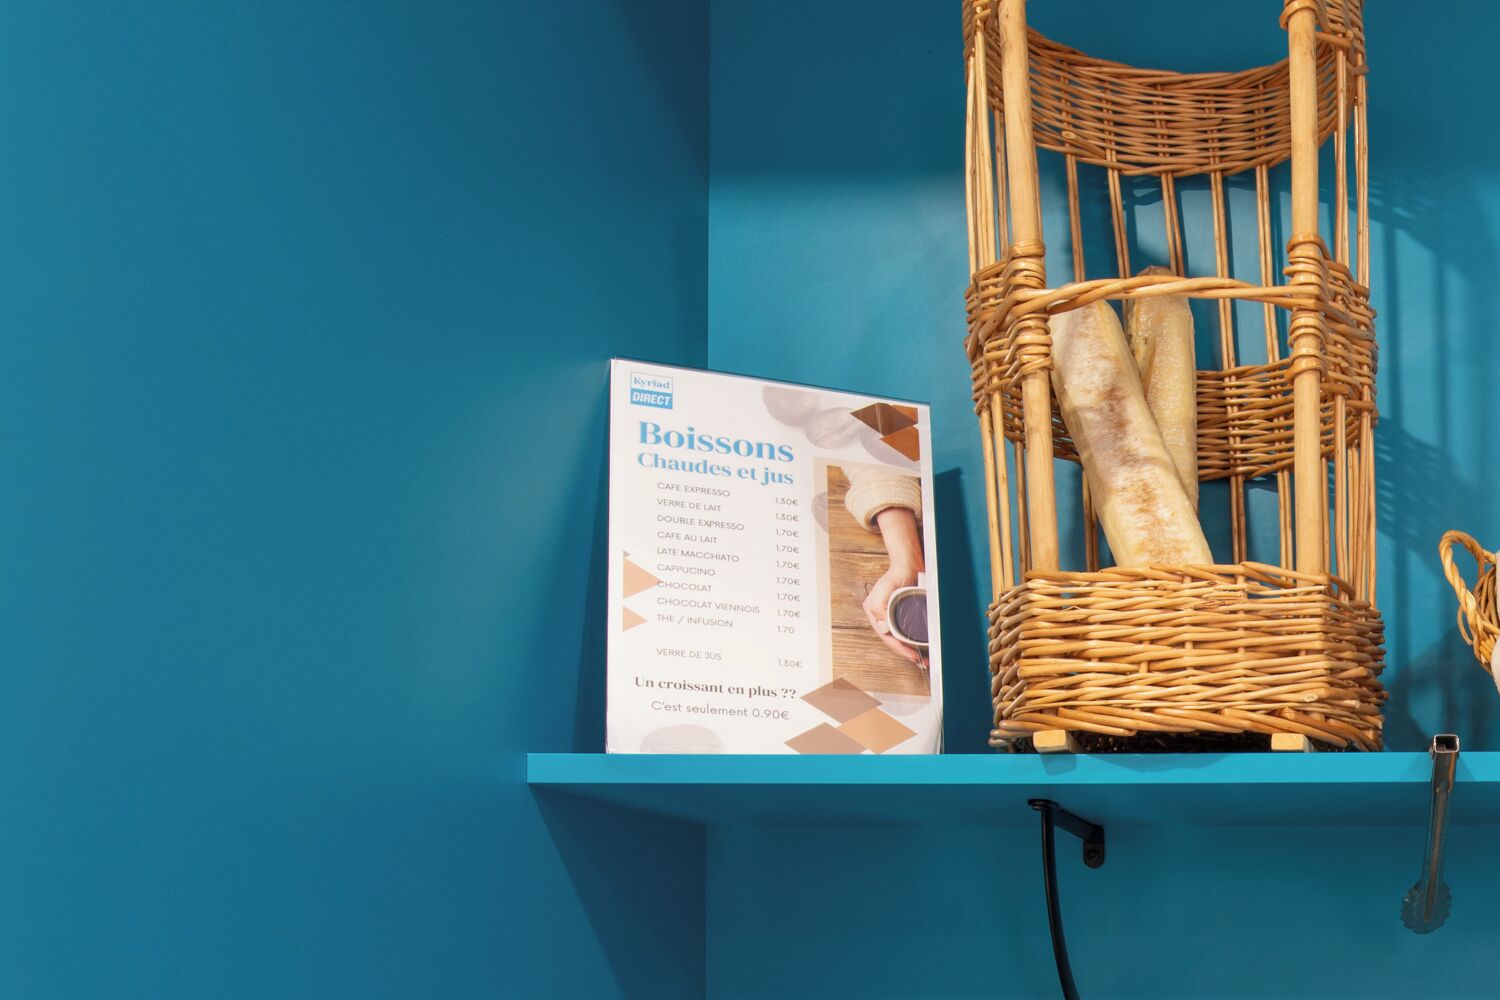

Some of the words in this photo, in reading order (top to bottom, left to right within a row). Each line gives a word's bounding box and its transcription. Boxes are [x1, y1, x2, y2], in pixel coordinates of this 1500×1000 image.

[633, 376, 670, 389] Kyriad
[632, 391, 671, 406] DIRECT
[639, 421, 794, 463] Boissons
[637, 452, 732, 477] Chaudes
[737, 468, 757, 481] et
[760, 467, 794, 486] jus
[657, 482, 681, 492] CAFE
[684, 485, 730, 497] EXPRESSO
[775, 497, 799, 506] 1.30€
[657, 498, 685, 508] VERRE
[689, 502, 701, 510] DE
[704, 504, 721, 512] LAIT
[775, 512, 799, 522] 1.30€
[657, 514, 696, 526] DOUBLE
[698, 519, 745, 531] EXPRESSO
[775, 528, 799, 538] 1.70€
[657, 531, 681, 540] CAFE
[684, 534, 697, 542] AU
[700, 536, 718, 544] LAIT
[775, 544, 799, 554] 1.70€
[657, 547, 678, 556] LATE
[681, 549, 740, 562] MACCHIATO
[776, 560, 800, 570] 1.70€
[657, 563, 716, 576] CAPPUCINO
[776, 576, 800, 586] 1.70€
[657, 580, 712, 592] CHOCOLAT
[776, 592, 800, 602] 1.70€
[657, 597, 712, 609] CHOCOLAT
[715, 602, 760, 613] VIENNOIS
[777, 609, 801, 618] 1.70€
[657, 614, 675, 622] THE
[687, 617, 733, 628] INFUSION
[777, 625, 794, 634] 1.70
[656, 648, 686, 658] VERRE
[689, 650, 701, 659] DE
[704, 652, 722, 660] JUS
[778, 659, 802, 668] 1.30€
[635, 676, 654, 688] Un
[658, 680, 723, 694] croissant
[727, 686, 744, 695] en
[748, 686, 778, 698] plus
[781, 688, 796, 699] ??
[651, 700, 682, 712] C'est
[686, 703, 748, 717] seulement
[752, 708, 790, 720] 0.90€
